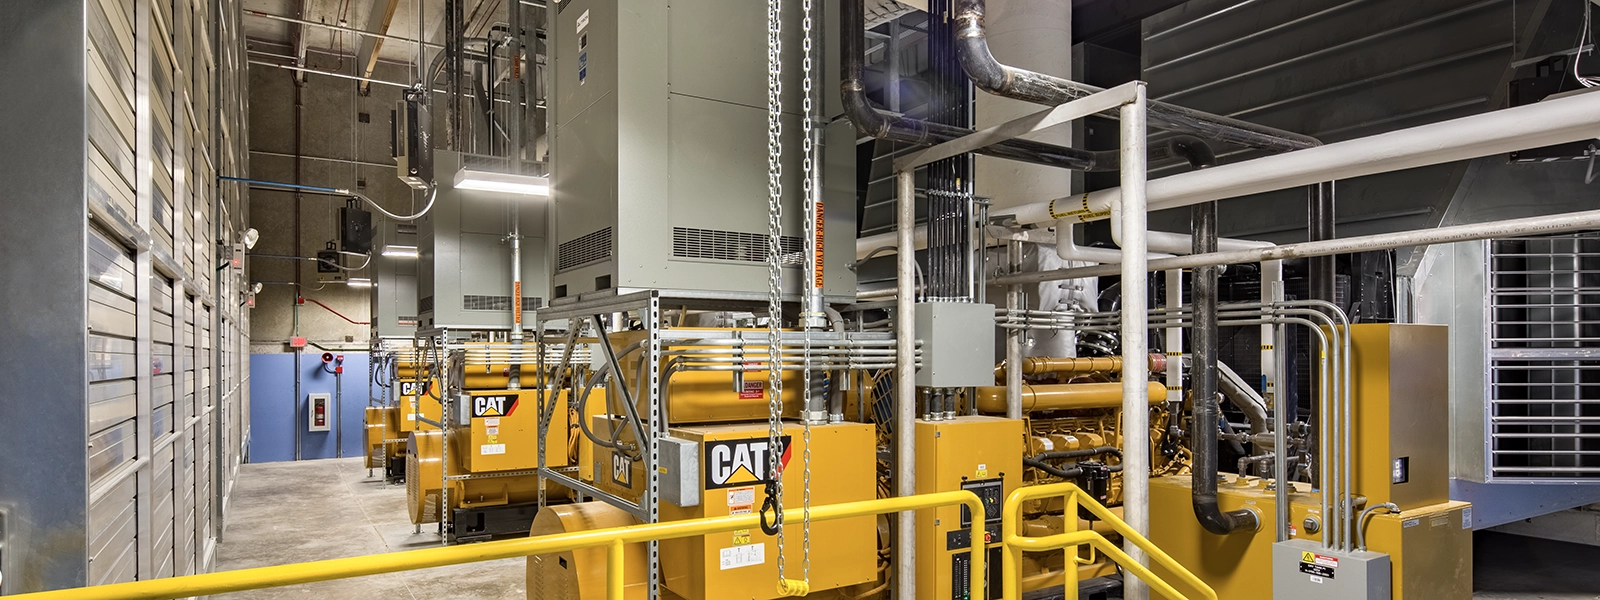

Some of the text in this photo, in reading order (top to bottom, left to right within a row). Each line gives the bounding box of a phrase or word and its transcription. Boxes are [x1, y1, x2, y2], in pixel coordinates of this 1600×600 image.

[816, 202, 824, 288] DANGER-HIGH VOLTAGE
[475, 397, 505, 416] CAT
[613, 454, 630, 485] CAT
[711, 442, 768, 485] CAT
